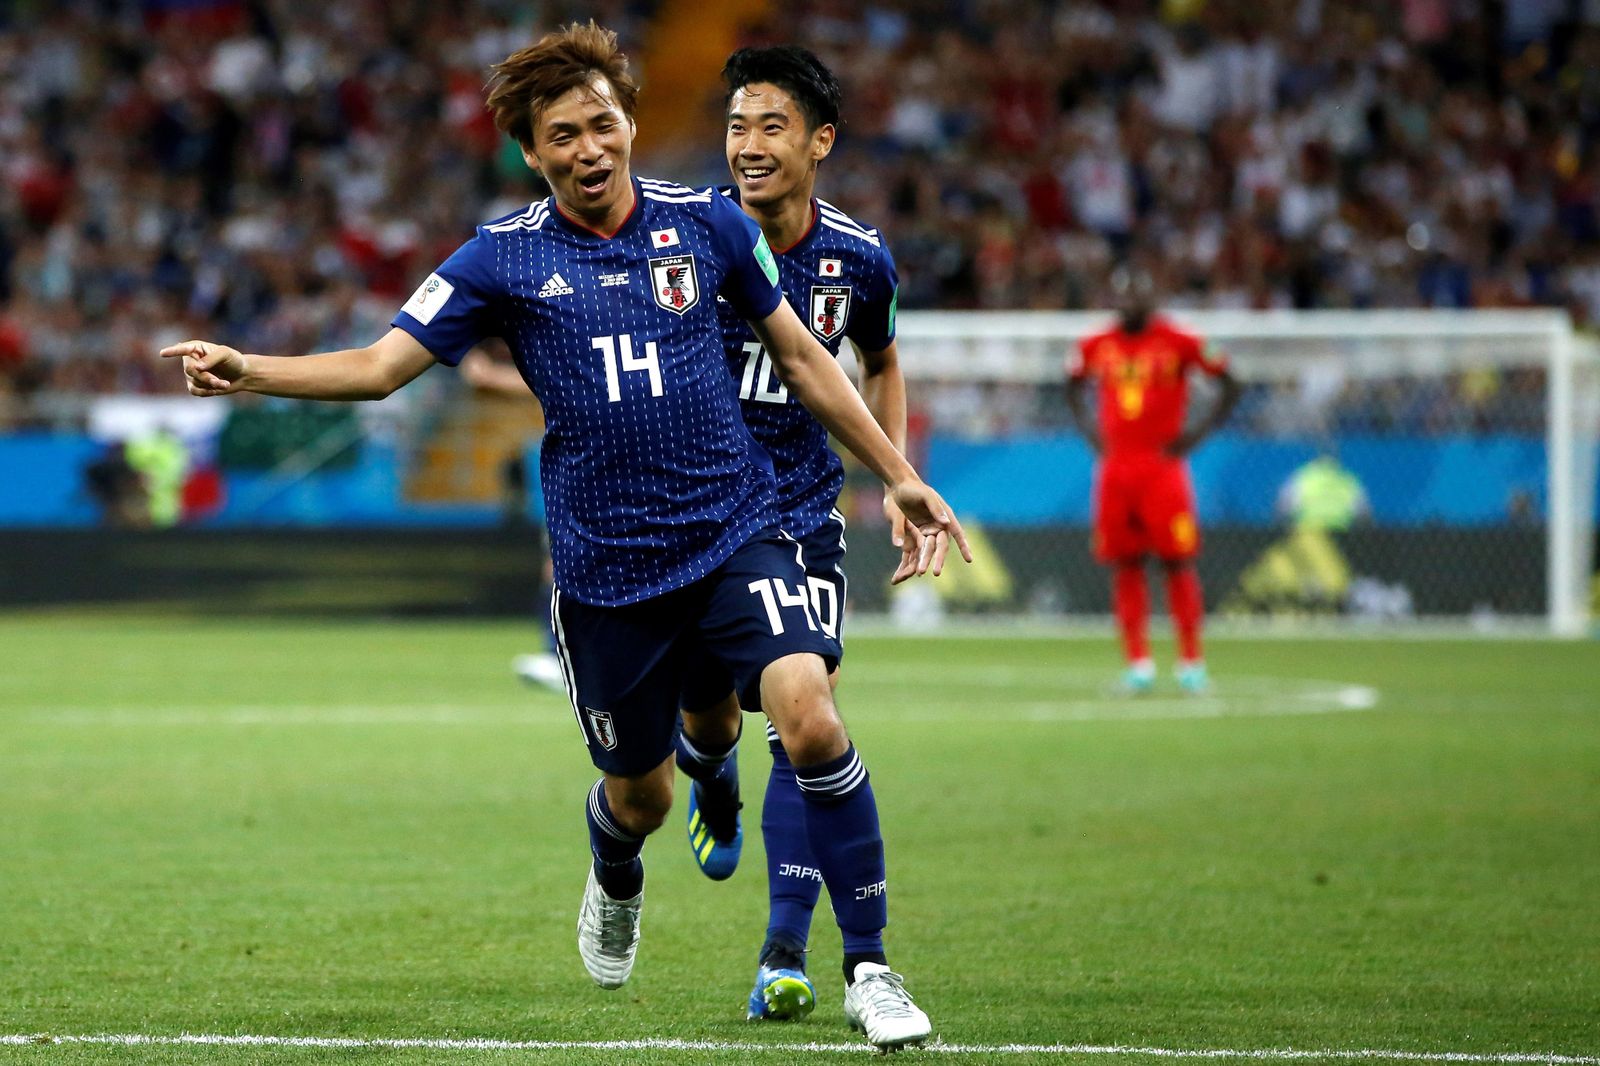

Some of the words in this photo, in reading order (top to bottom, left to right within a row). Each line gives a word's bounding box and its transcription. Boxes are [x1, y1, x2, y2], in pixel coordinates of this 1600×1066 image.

[660, 258, 683, 266] JAPAN
[538, 286, 574, 298] adidas
[591, 334, 663, 403] 14
[779, 863, 824, 882] JAPA
[855, 879, 887, 900] JAP
